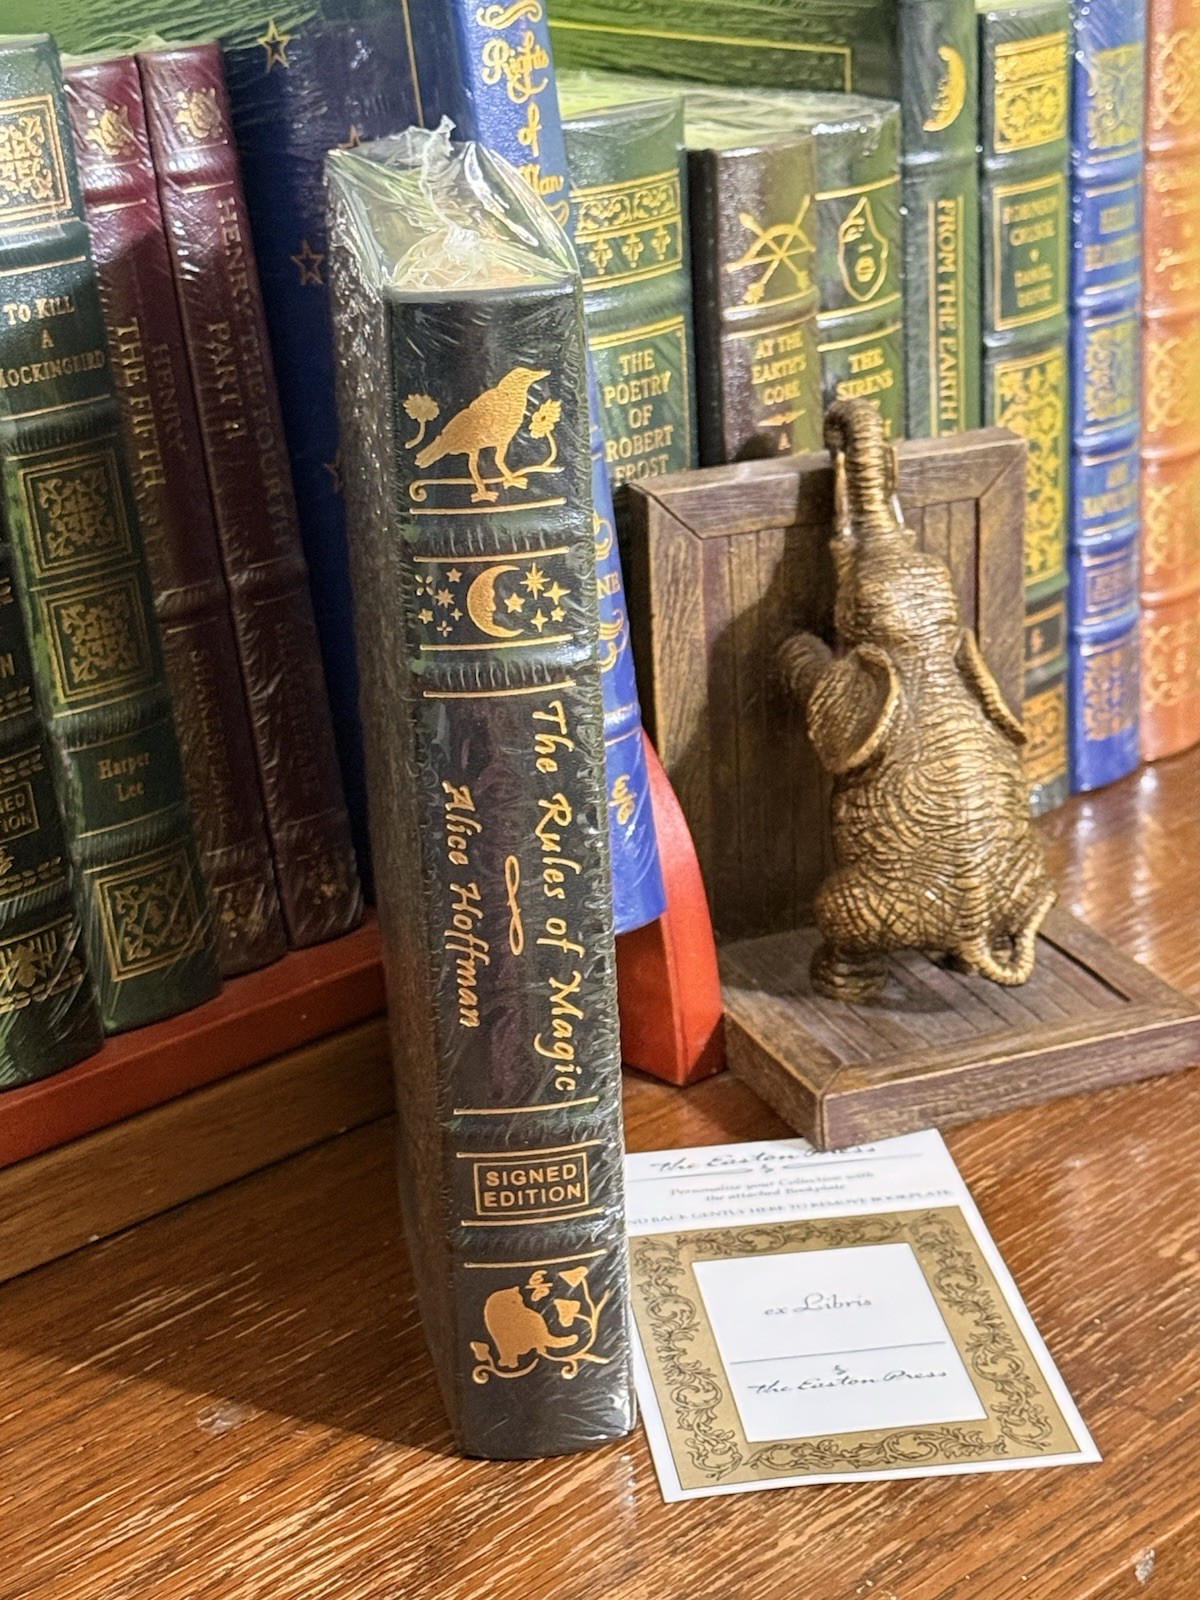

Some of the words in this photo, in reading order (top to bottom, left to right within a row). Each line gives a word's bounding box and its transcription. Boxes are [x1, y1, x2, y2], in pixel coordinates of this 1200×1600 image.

[517, 102, 542, 158] of
[937, 198, 956, 273] FROM
[2, 302, 32, 326] TO
[33, 295, 76, 320] KILL
[938, 280, 957, 331] THE
[41, 328, 55, 349] A
[114, 317, 149, 388] THE
[755, 338, 776, 360] AT
[776, 330, 804, 353] THE
[207, 320, 244, 407] PART
[618, 348, 656, 376] THE
[848, 347, 885, 374] THE
[603, 370, 671, 408] POETRY
[763, 380, 801, 406] CORE
[836, 368, 894, 401] SIRENS
[939, 336, 958, 420] EARTH
[627, 404, 653, 429] OF
[129, 394, 167, 489] FIFTH
[605, 424, 674, 462] ROBERT
[614, 453, 669, 487] FROST
[532, 700, 575, 774] The
[97, 752, 150, 780] Harper
[115, 782, 144, 802] Lee
[441, 780, 483, 866] Alice
[535, 792, 582, 900] Rules
[536, 917, 586, 959] of
[443, 882, 491, 1028] Hoffman
[534, 970, 585, 1092] Magic
[485, 1163, 578, 1188] SIGNED
[706, 1152, 798, 1167] Easton
[845, 1171, 874, 1181] with
[483, 1182, 582, 1208] EDITION
[705, 1193, 726, 1202] the
[728, 1188, 781, 1200] attached
[627, 1217, 649, 1226] ND
[651, 1213, 690, 1224] BACK
[691, 1208, 746, 1219] GENTLY
[749, 1205, 785, 1214] HERE
[788, 1201, 808, 1210] TO
[764, 1307, 788, 1316] ex
[793, 1292, 873, 1312] Libris
[797, 1373, 879, 1391] Easton
[883, 1369, 948, 1382] Press
